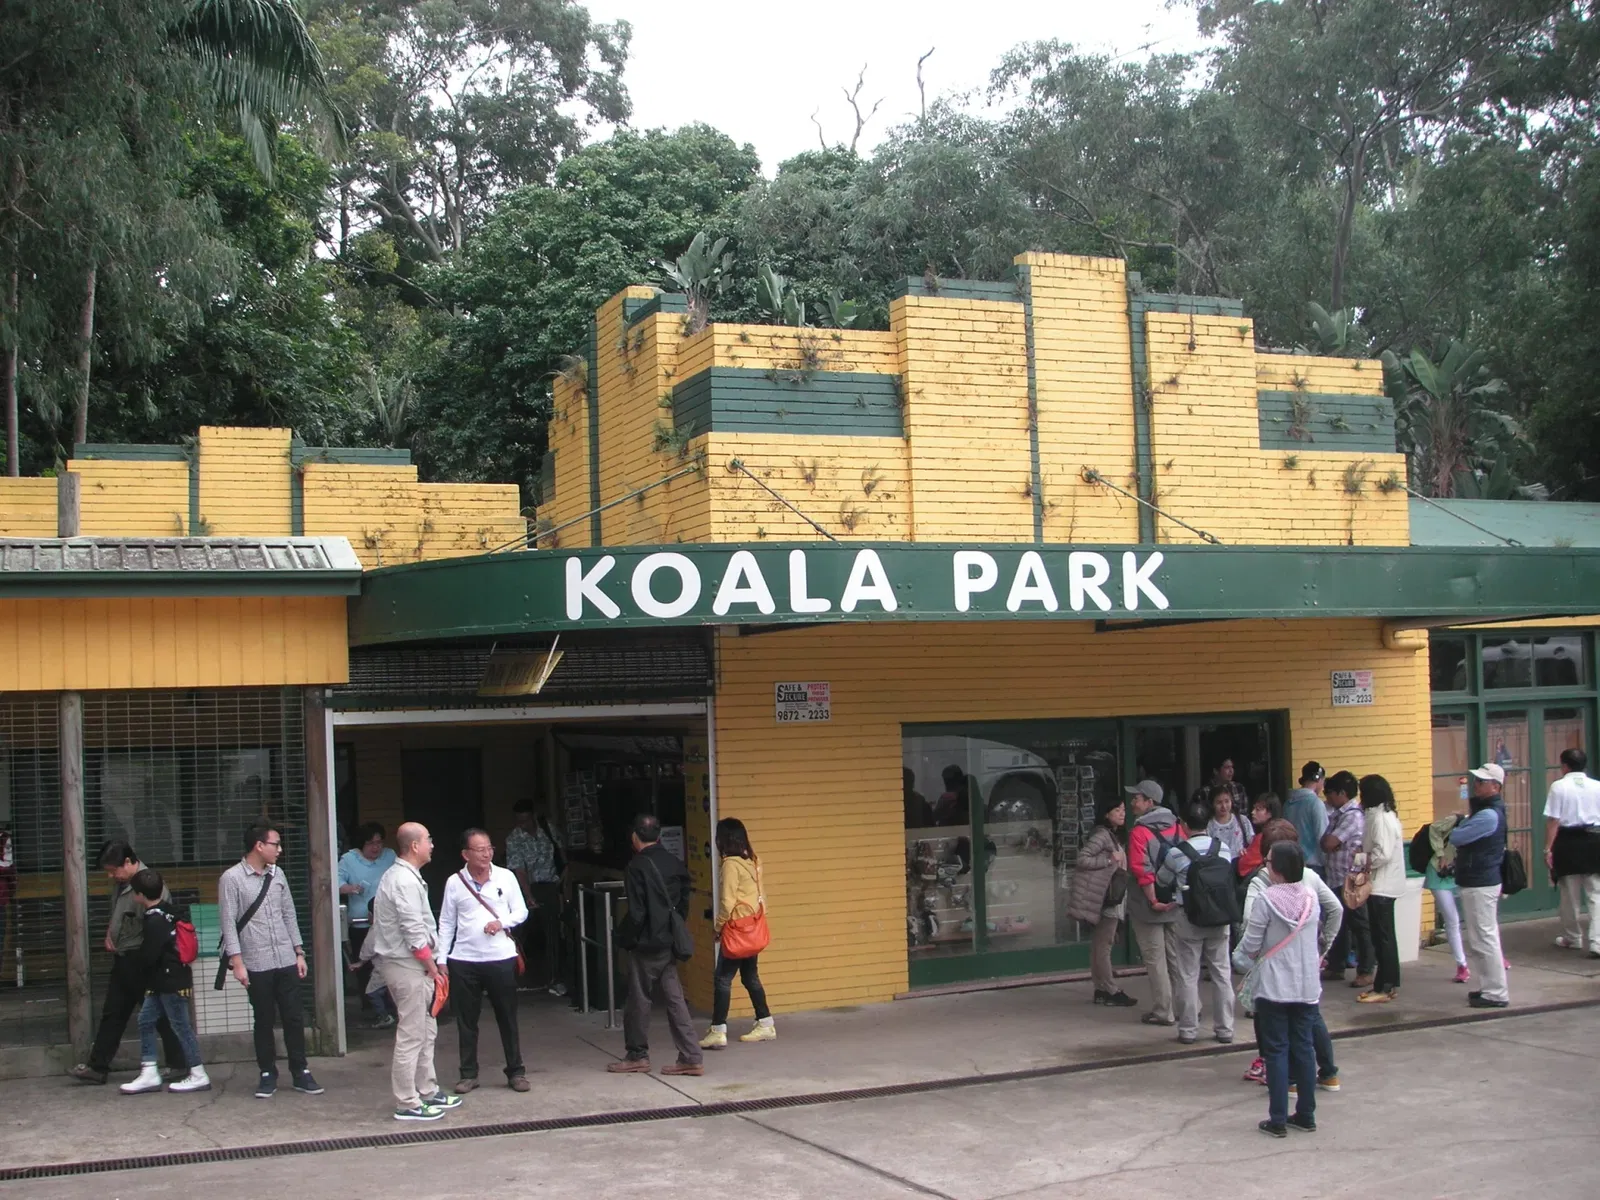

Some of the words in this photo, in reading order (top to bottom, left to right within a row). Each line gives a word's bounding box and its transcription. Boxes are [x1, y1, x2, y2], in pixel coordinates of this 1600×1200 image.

[564, 548, 899, 621] KOALA
[952, 549, 1171, 613] PARK
[777, 684, 796, 692] SAFE
[777, 692, 806, 701] SECURE
[777, 710, 800, 721] 9872
[808, 710, 830, 720] 2233
